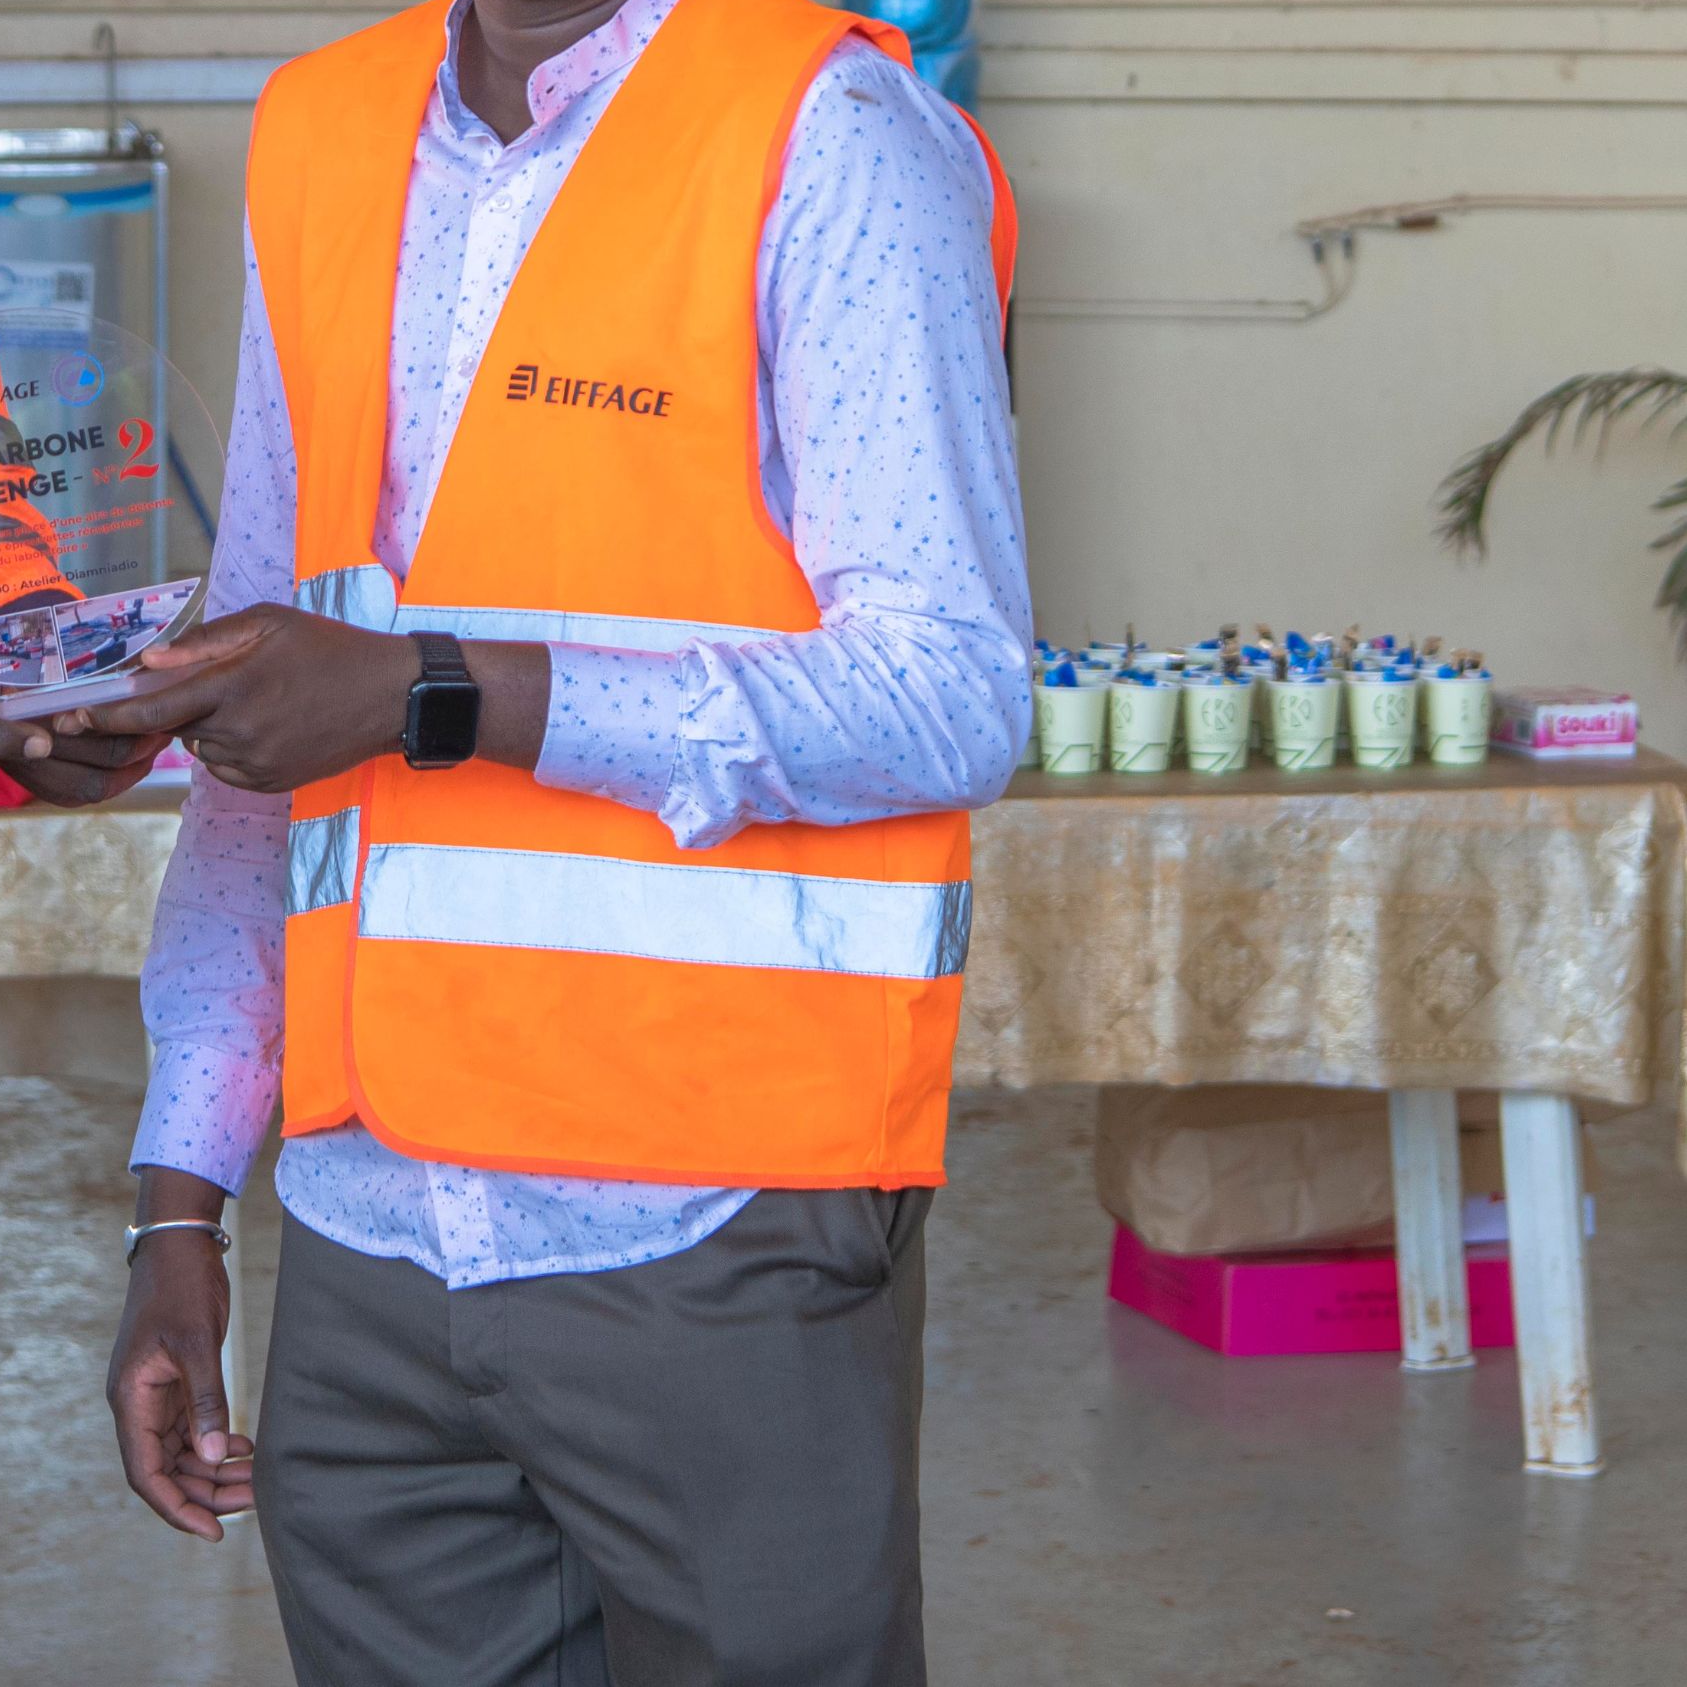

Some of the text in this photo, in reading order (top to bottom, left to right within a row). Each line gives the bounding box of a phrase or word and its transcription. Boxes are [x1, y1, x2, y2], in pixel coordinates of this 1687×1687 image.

[545, 377, 674, 417] EIFFAGE
[118, 417, 160, 481] 2
[20, 573, 63, 590] Atelier
[65, 559, 139, 581] Diamniadio
